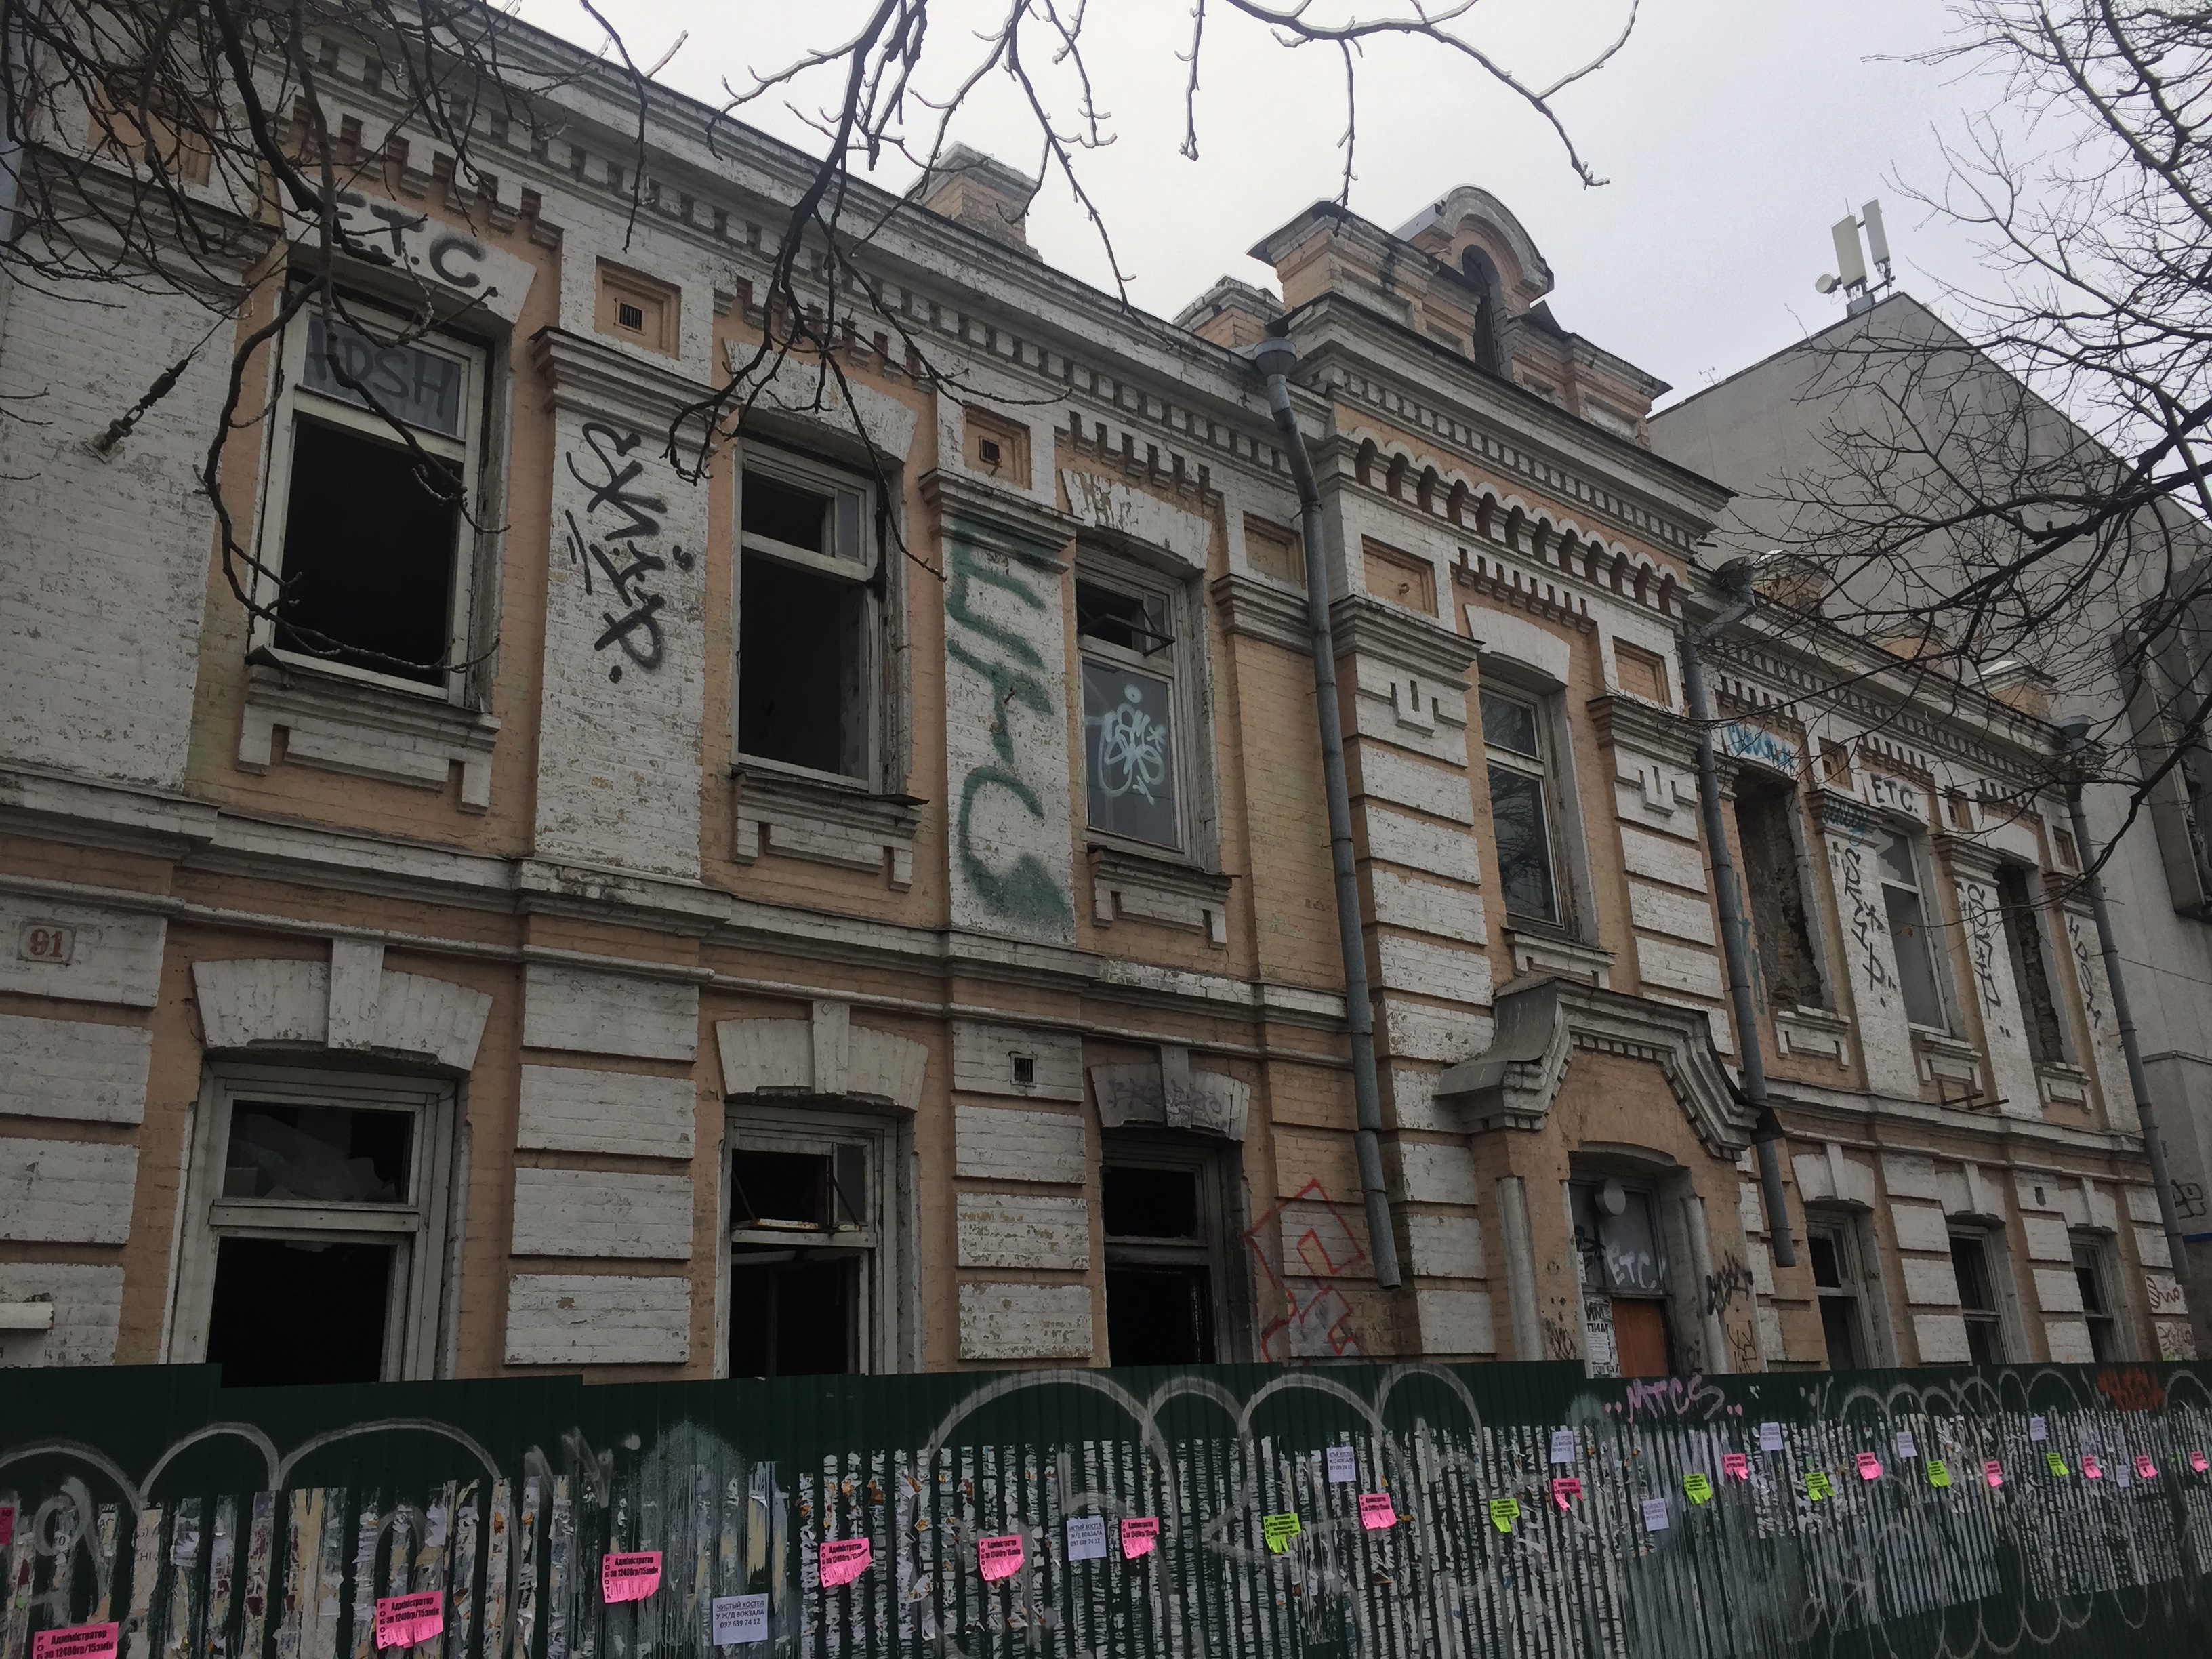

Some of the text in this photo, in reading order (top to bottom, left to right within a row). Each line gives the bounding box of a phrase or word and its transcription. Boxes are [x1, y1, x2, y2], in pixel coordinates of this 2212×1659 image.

[30, 928, 64, 958] 91
[717, 1600, 764, 1610] ЧИСТЫЙ ХОСТЕЛ
[722, 1612, 735, 1620] Ж/Д
[737, 1609, 764, 1618] ВОКЗАЛА
[380, 1603, 388, 1646] РОБОТА
[51, 1630, 107, 1645] Адміністратор
